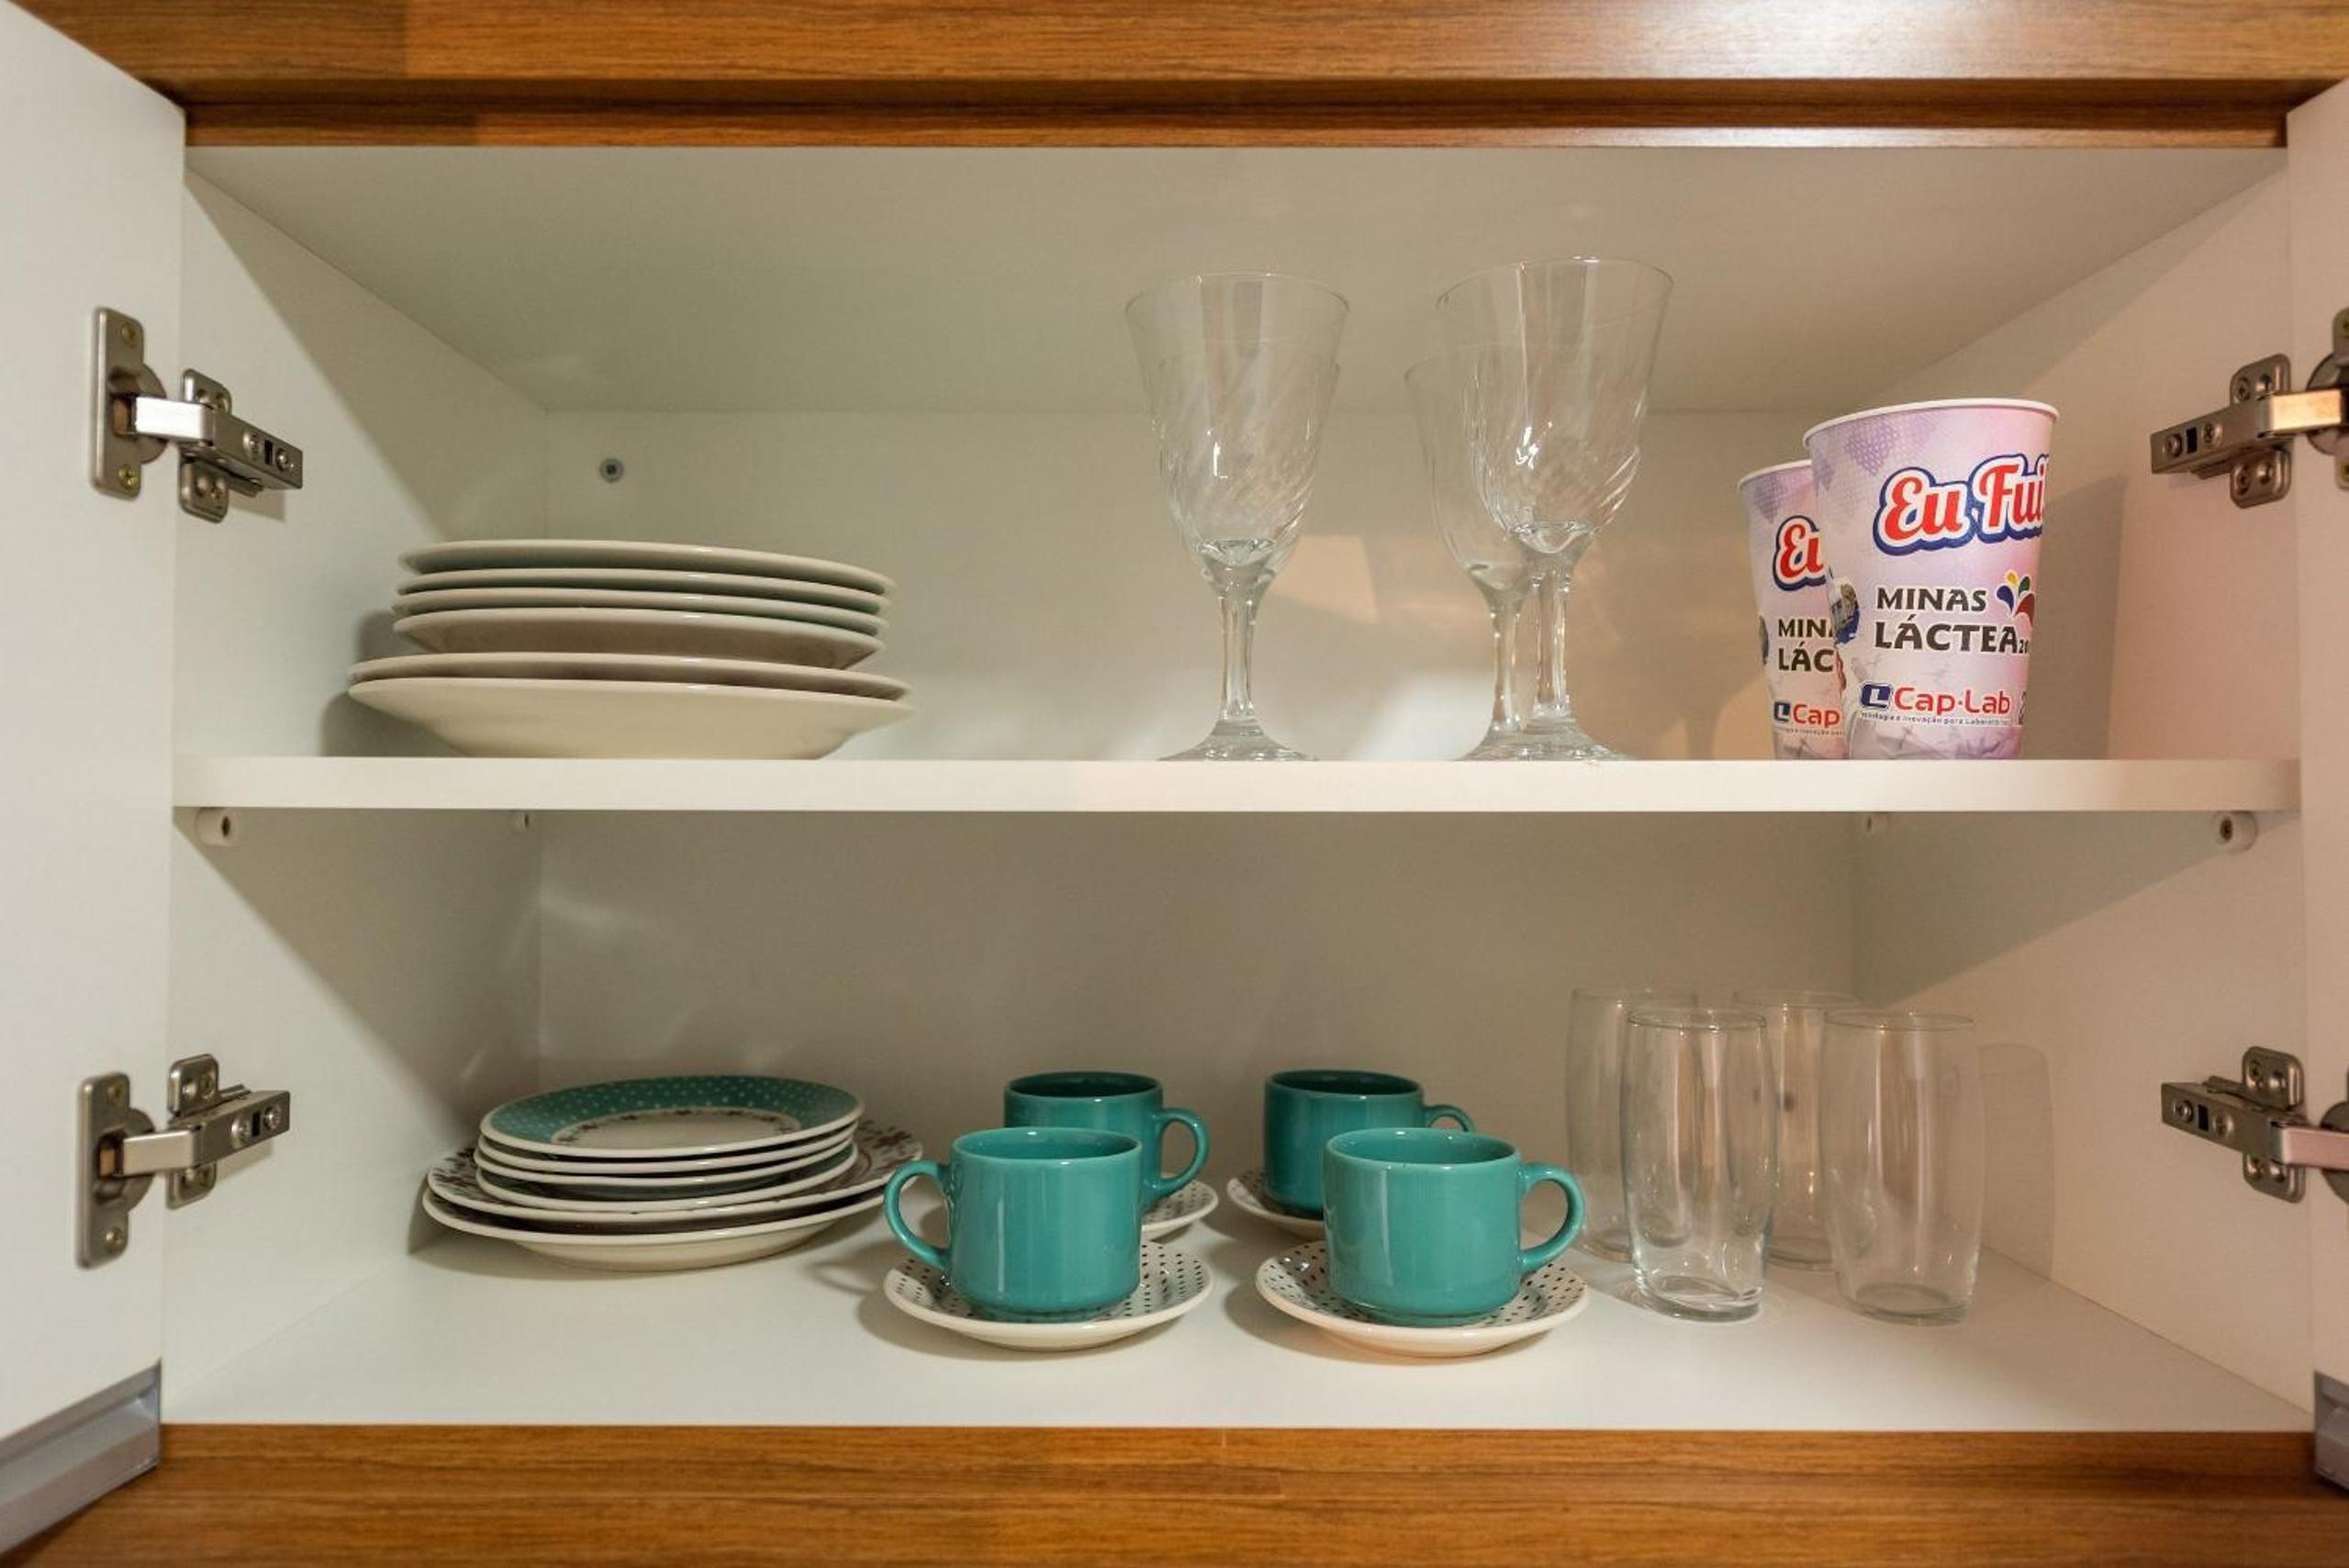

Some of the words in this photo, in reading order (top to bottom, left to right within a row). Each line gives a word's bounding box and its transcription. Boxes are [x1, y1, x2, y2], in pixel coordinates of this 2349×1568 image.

[1881, 471, 1968, 546] Eu
[1973, 457, 2046, 534] Fui
[1877, 587, 1986, 612] MINAS
[1778, 619, 1833, 638] MIN
[1875, 614, 2018, 654] LÁCTEA
